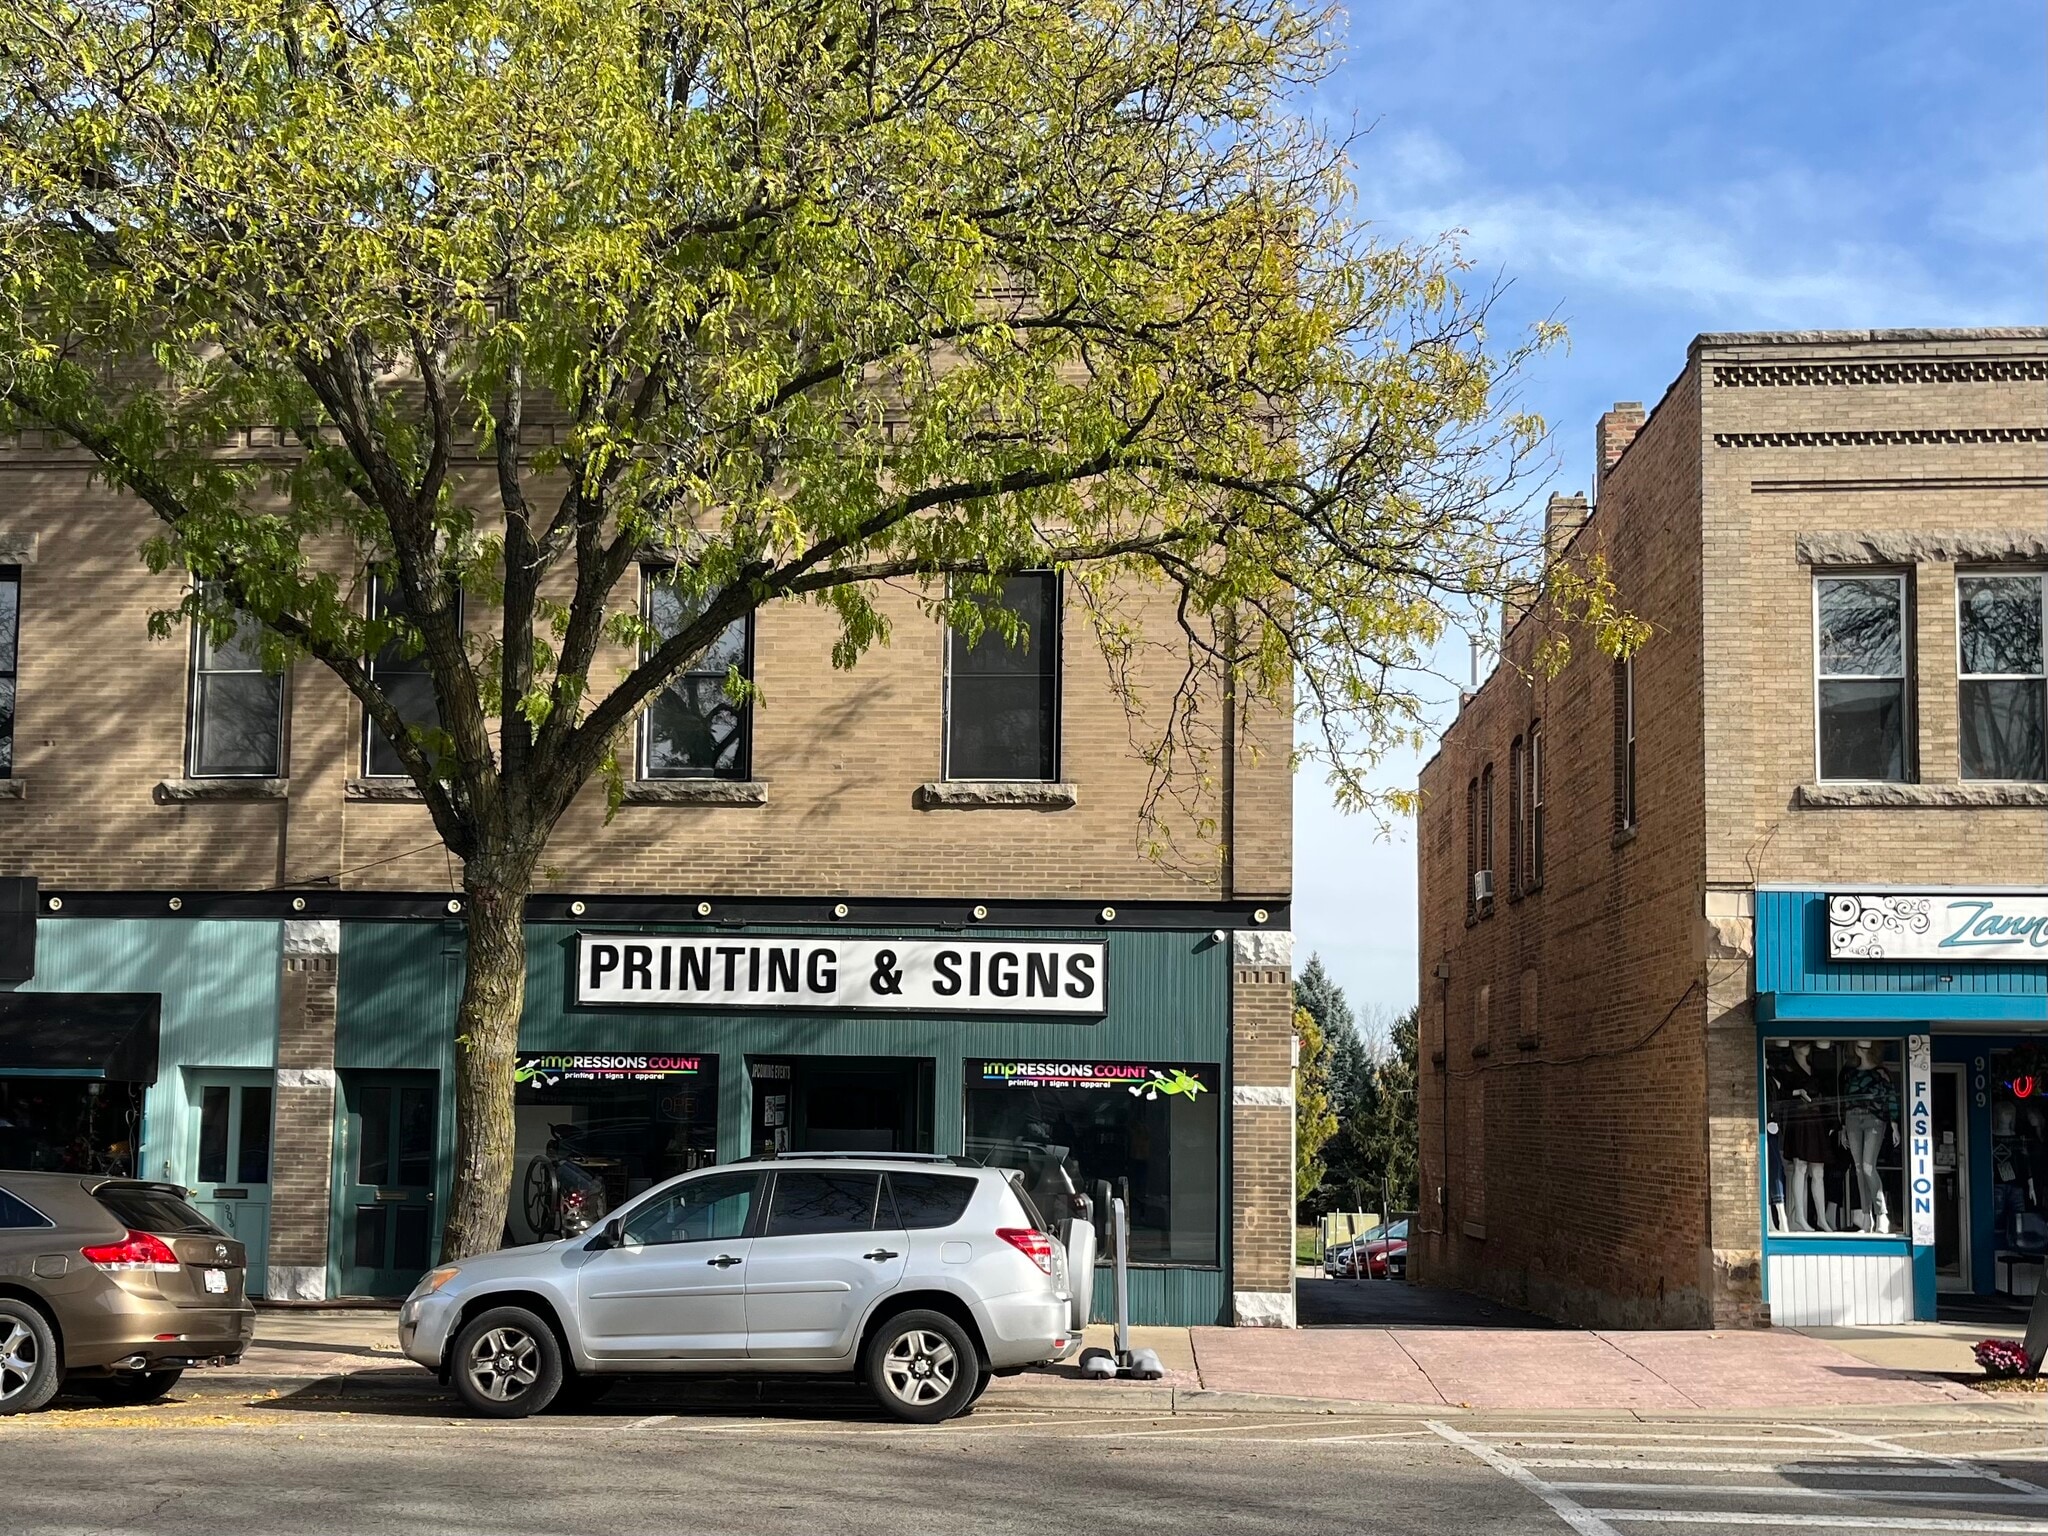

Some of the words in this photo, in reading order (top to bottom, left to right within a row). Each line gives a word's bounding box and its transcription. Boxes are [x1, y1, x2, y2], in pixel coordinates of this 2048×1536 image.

[590, 944, 838, 993] PRINTING
[869, 949, 904, 994] &
[932, 950, 1097, 998] SIGNS
[648, 1057, 700, 1070] COUNT
[1094, 1065, 1148, 1078] COUNT
[564, 1072, 594, 1080] printing
[1008, 1079, 1038, 1087] printing
[1049, 1080, 1069, 1088] signs
[1080, 1080, 1111, 1089] apparel
[1974, 1056, 1986, 1108] 909
[1912, 1081, 1931, 1214] FASHION
[225, 1204, 235, 1228] 903
